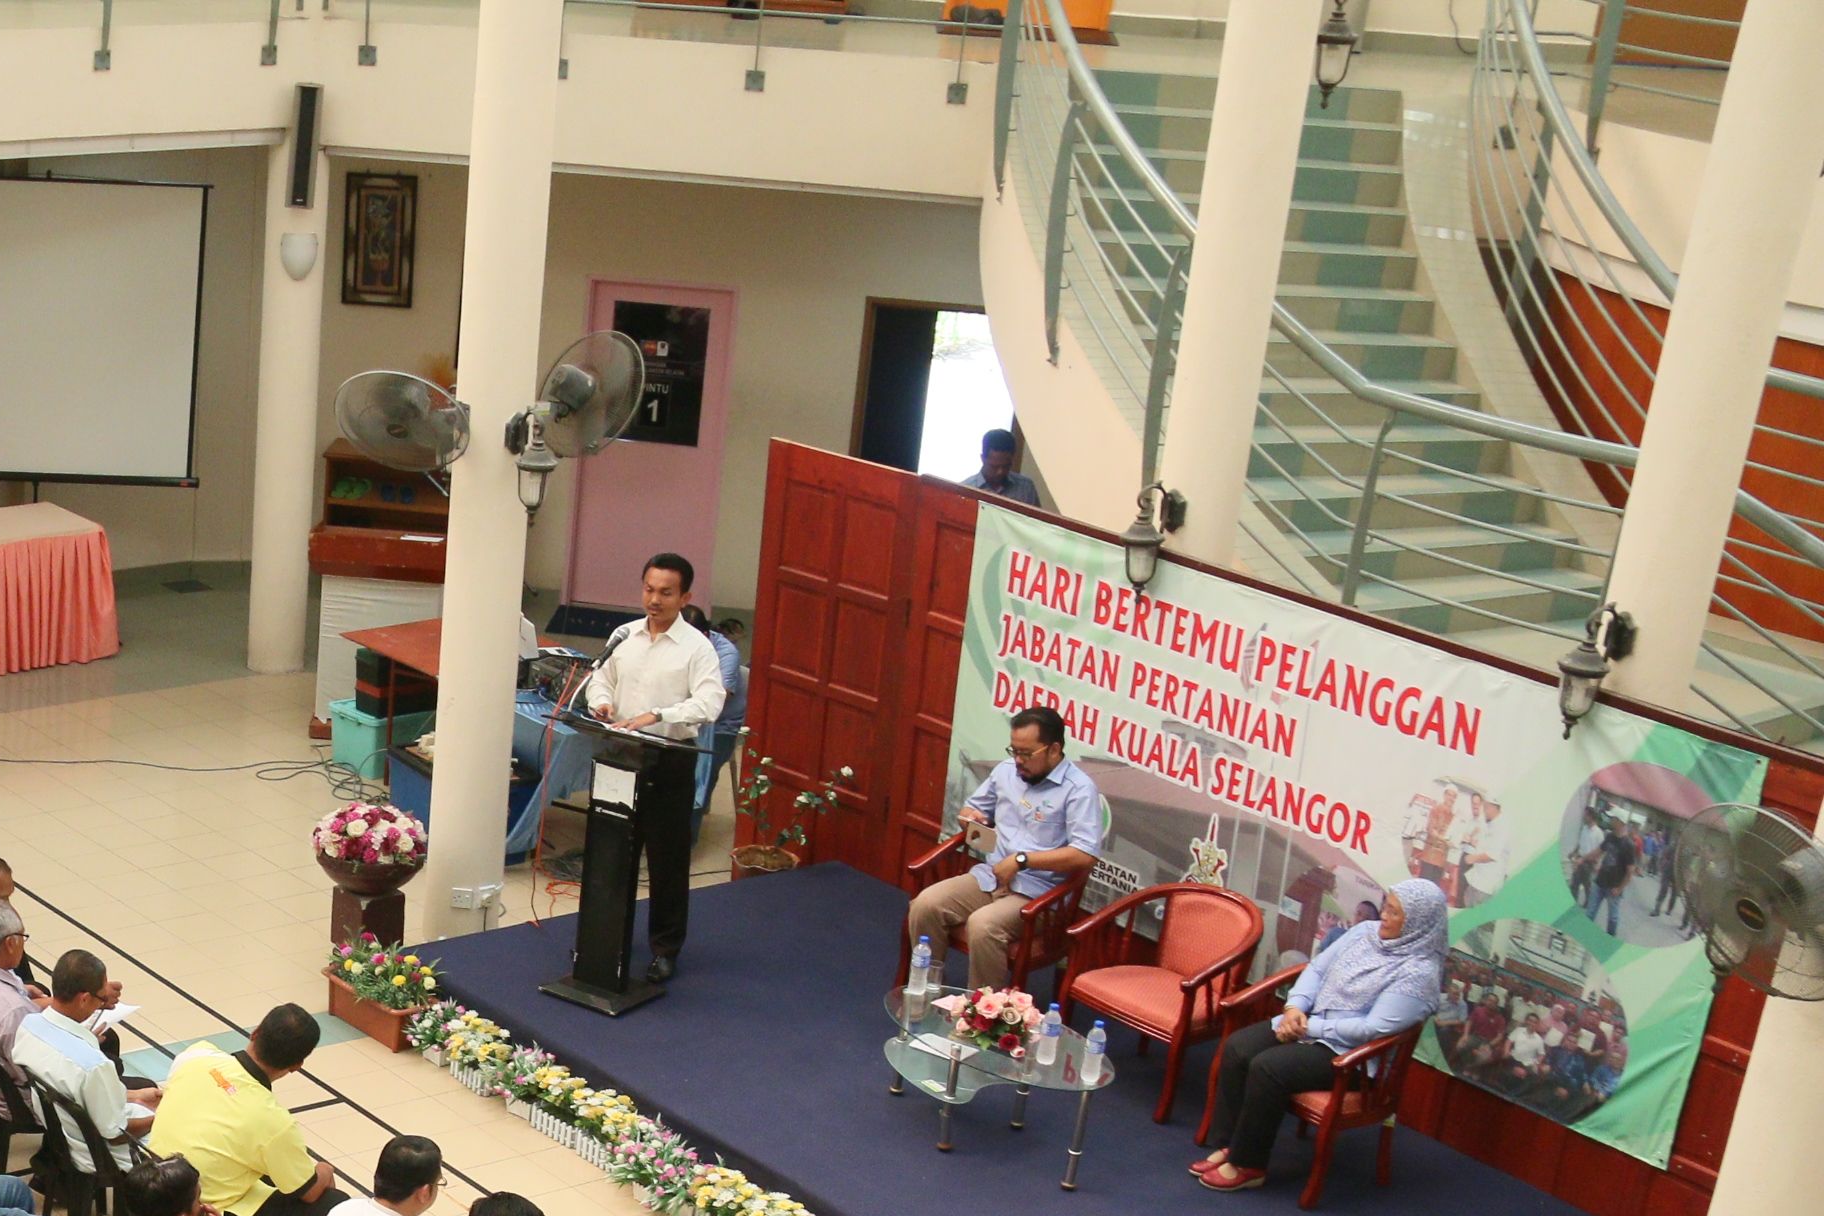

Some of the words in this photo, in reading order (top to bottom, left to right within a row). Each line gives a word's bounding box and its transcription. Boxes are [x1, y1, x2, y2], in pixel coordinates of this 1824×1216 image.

[643, 383, 669, 393] INTU
[647, 399, 658, 422] 1
[999, 614, 1121, 692] JABATAN
[1129, 661, 1297, 758] PERTANIAN
[1008, 551, 1082, 616] HARI
[1094, 580, 1244, 673] BERTEMU
[1254, 638, 1482, 756] PELANGGAN
[1107, 716, 1199, 788] KUALA
[1212, 757, 1372, 854] SELANGOR
